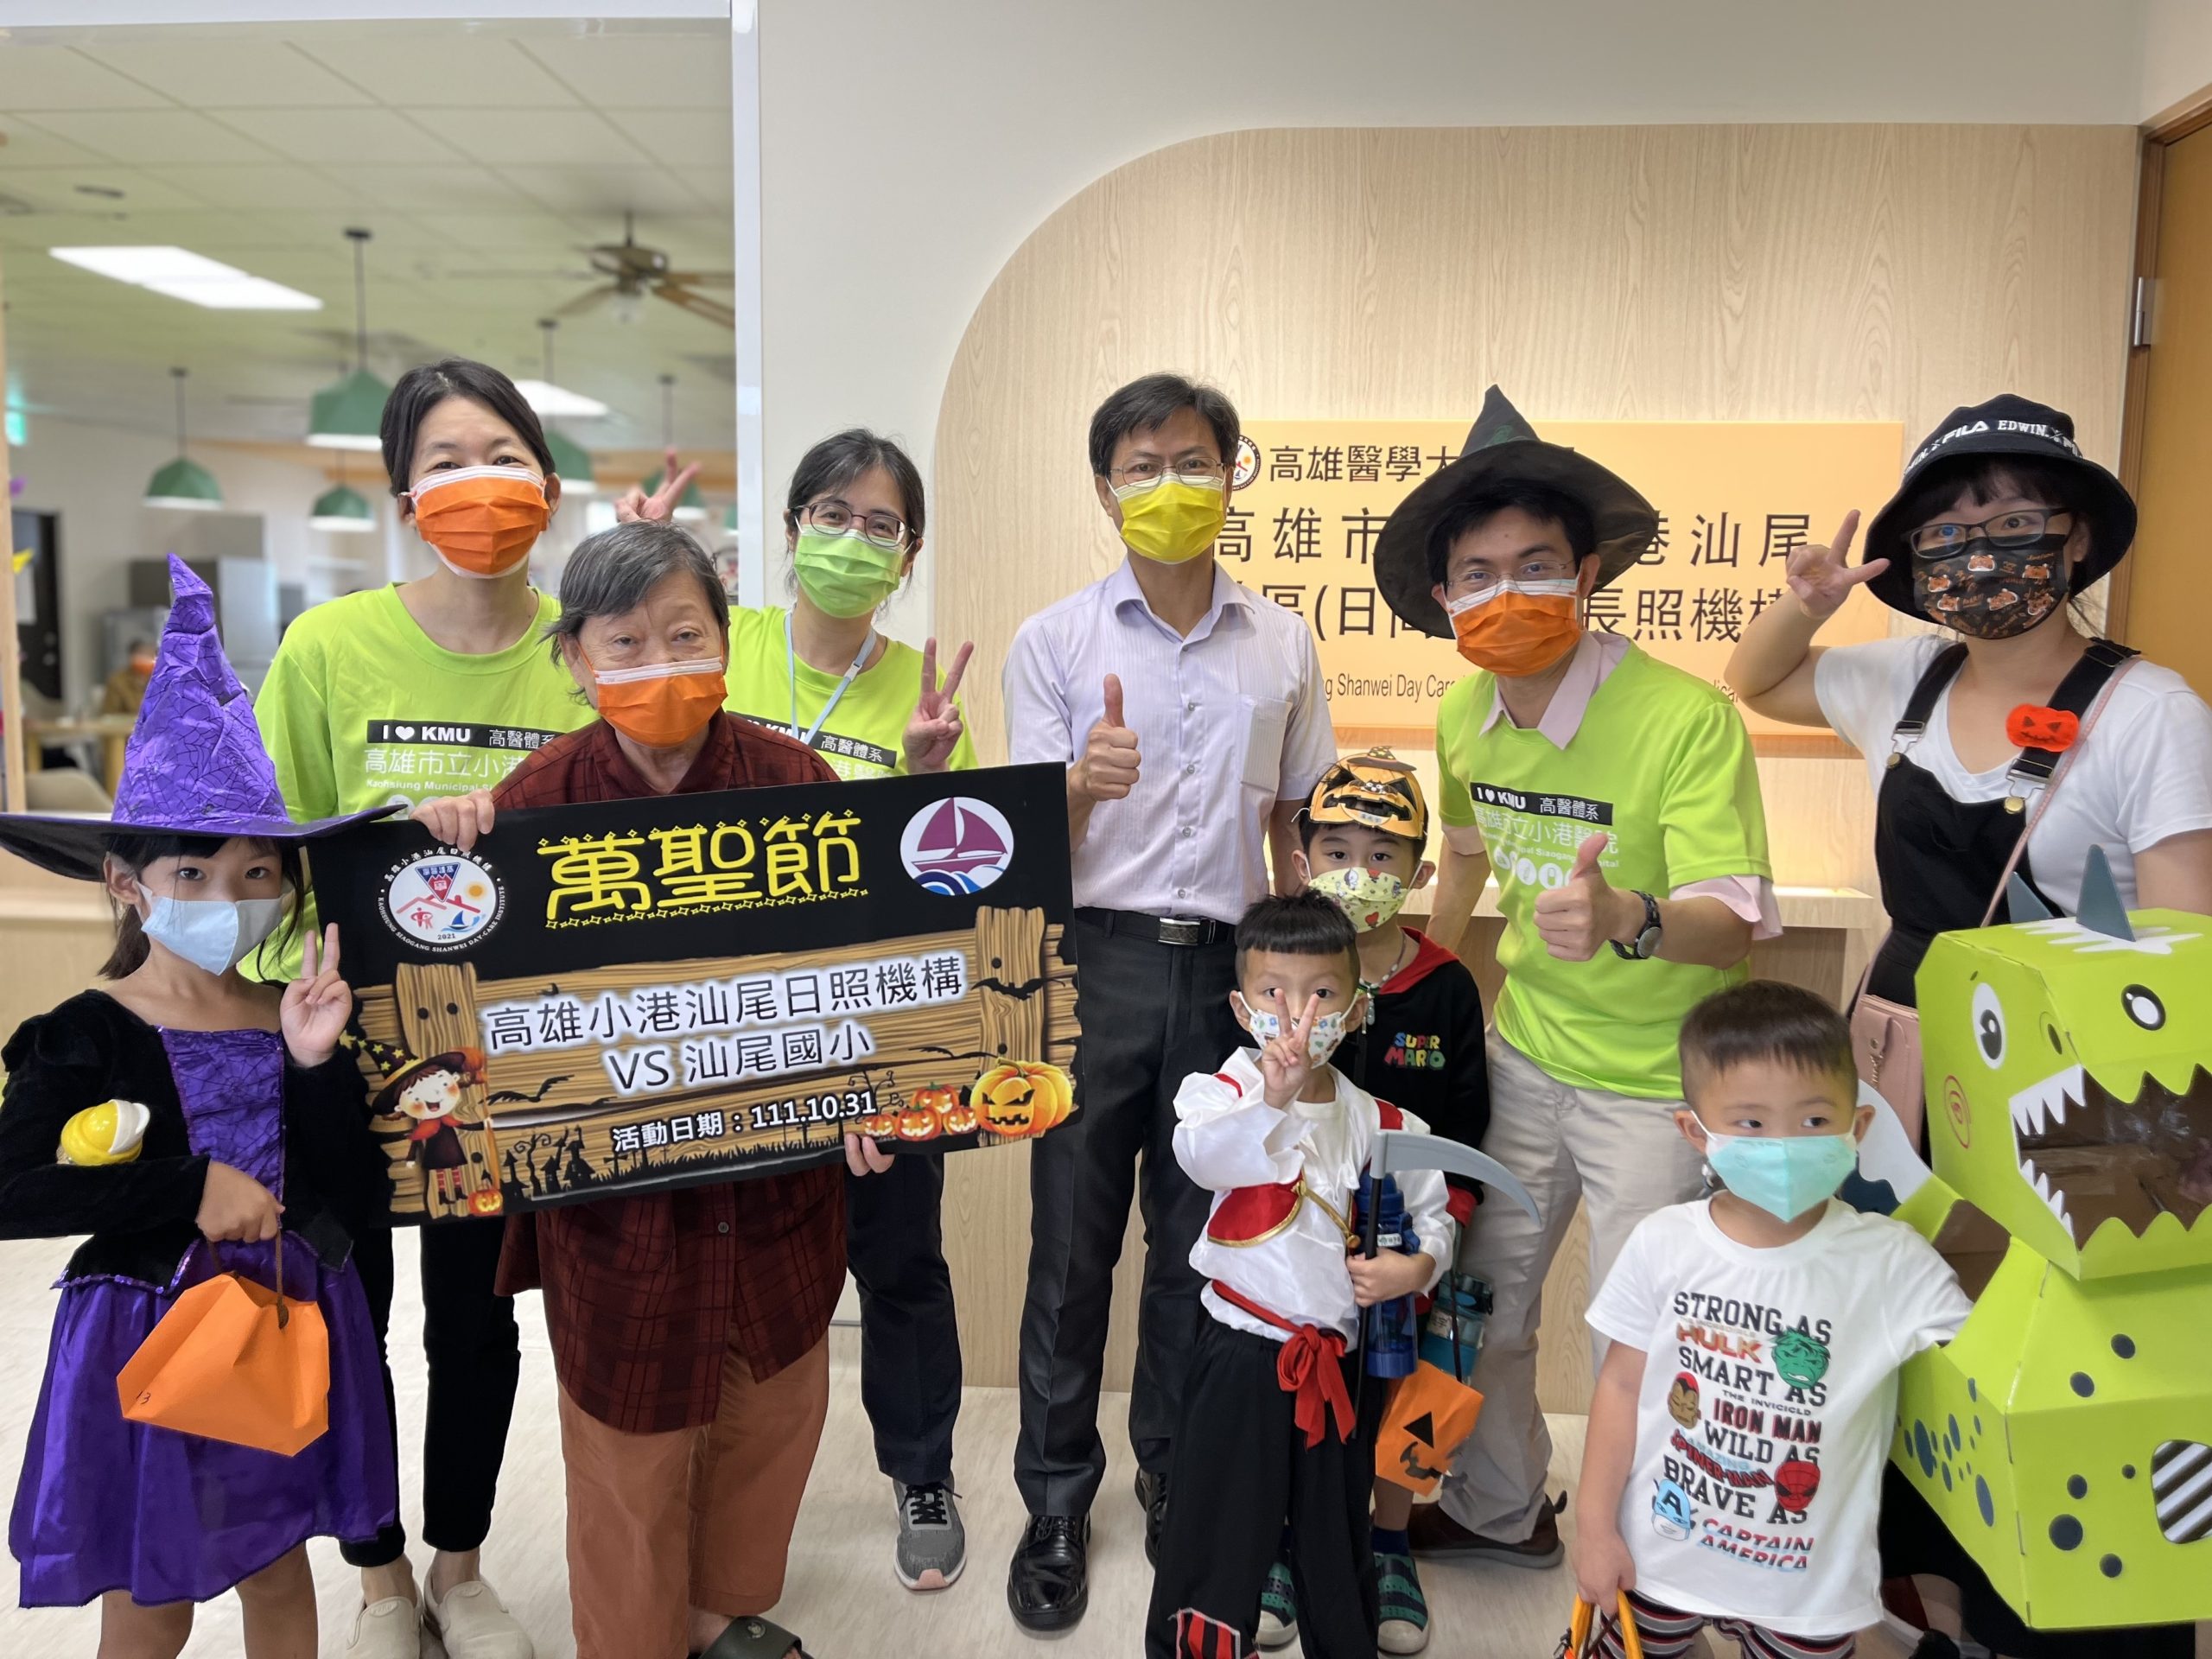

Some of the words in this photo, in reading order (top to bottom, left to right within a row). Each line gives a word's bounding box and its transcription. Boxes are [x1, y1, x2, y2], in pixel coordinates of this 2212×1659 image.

[1942, 420, 1988, 444] FILA
[1337, 672, 1393, 698] Shanwei
[1396, 673, 1423, 703] Day
[383, 724, 389, 740] I
[422, 726, 471, 743] KMU
[820, 734, 883, 763] 高醫體系
[366, 779, 422, 791] Kaohsiung
[424, 780, 476, 792] Municipal
[1477, 786, 1484, 801] I
[1497, 791, 1527, 810] KMU
[1540, 796, 1599, 822] 高醫體系
[536, 815, 864, 922] 萬聖節
[378, 897, 397, 933] KAOHSIUNG
[395, 931, 430, 952] SIAOGANG
[431, 942, 468, 952] SHANWEI
[468, 918, 499, 946] DAY-CARE
[495, 885, 506, 921] INSTITUTE
[486, 956, 963, 1050] 高雄小港汕尾日照機構
[607, 1049, 670, 1090] VS
[685, 1024, 871, 1083] 汕尾國小
[1383, 1046, 1446, 1070] MARO
[1394, 1032, 1441, 1050] SUPR
[1673, 1291, 1784, 1337] STRONG
[1794, 1314, 1833, 1347] AS
[1675, 1322, 1763, 1364] HULK
[1678, 1345, 1775, 1397] SMART
[1783, 1382, 1828, 1408] AS
[1722, 1389, 1745, 1402] THE
[1713, 1397, 1764, 1434] IRON
[1771, 1414, 1823, 1445] MAN
[1703, 1419, 1775, 1465] WILD
[1783, 1444, 1821, 1465] AS
[1663, 1453, 1757, 1520] BRAVE
[1698, 1534, 1808, 1573] AMERICA
[1701, 1517, 1815, 1553] CAPTAIN
